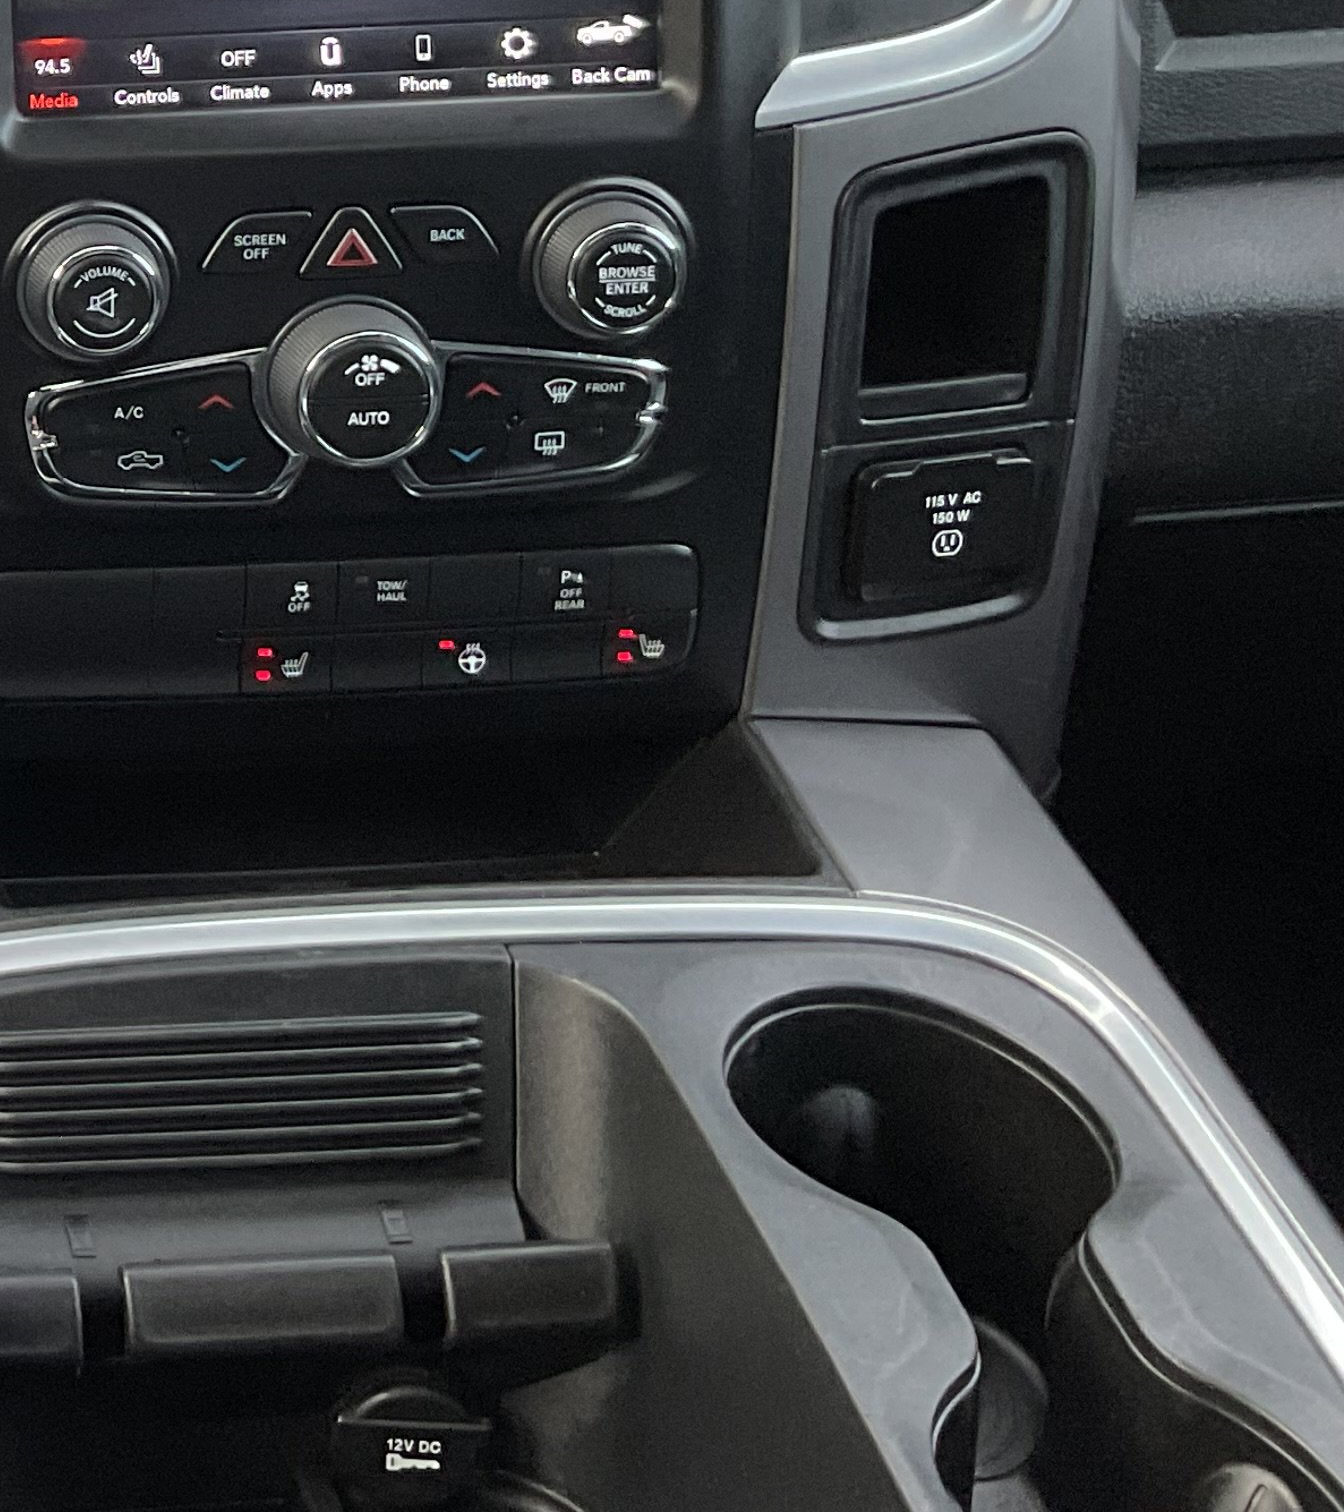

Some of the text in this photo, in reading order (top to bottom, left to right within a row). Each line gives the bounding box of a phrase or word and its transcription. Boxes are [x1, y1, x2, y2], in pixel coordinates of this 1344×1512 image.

[220, 49, 257, 67] OFF
[34, 58, 71, 75] 94.5
[487, 71, 550, 89] Settings
[572, 66, 652, 85] Back Cam
[311, 80, 353, 99] Apps
[399, 76, 450, 92] Phone
[29, 92, 79, 109] Media
[113, 87, 180, 105] Controls
[210, 85, 271, 101] Climate
[233, 233, 287, 248] SCREEN
[430, 228, 465, 242] BACK
[243, 248, 270, 261] OFF
[610, 242, 643, 255] TUNE
[79, 266, 129, 282] VOLUME
[598, 265, 656, 279] BROWSE
[605, 281, 649, 295] ENTER
[603, 304, 648, 318] SCROLL
[354, 373, 386, 387] OFF
[584, 382, 626, 394] FRONT
[114, 406, 144, 420] A/C
[347, 411, 390, 426] AUTO
[925, 491, 982, 508] 115 V AC
[932, 509, 970, 524] 150 W
[376, 580, 408, 591] TOW/
[376, 591, 407, 602] HAUL
[560, 588, 583, 599] OFF
[287, 602, 310, 613] OFF
[554, 599, 585, 611] REAR
[386, 1438, 442, 1454] 12V DC
